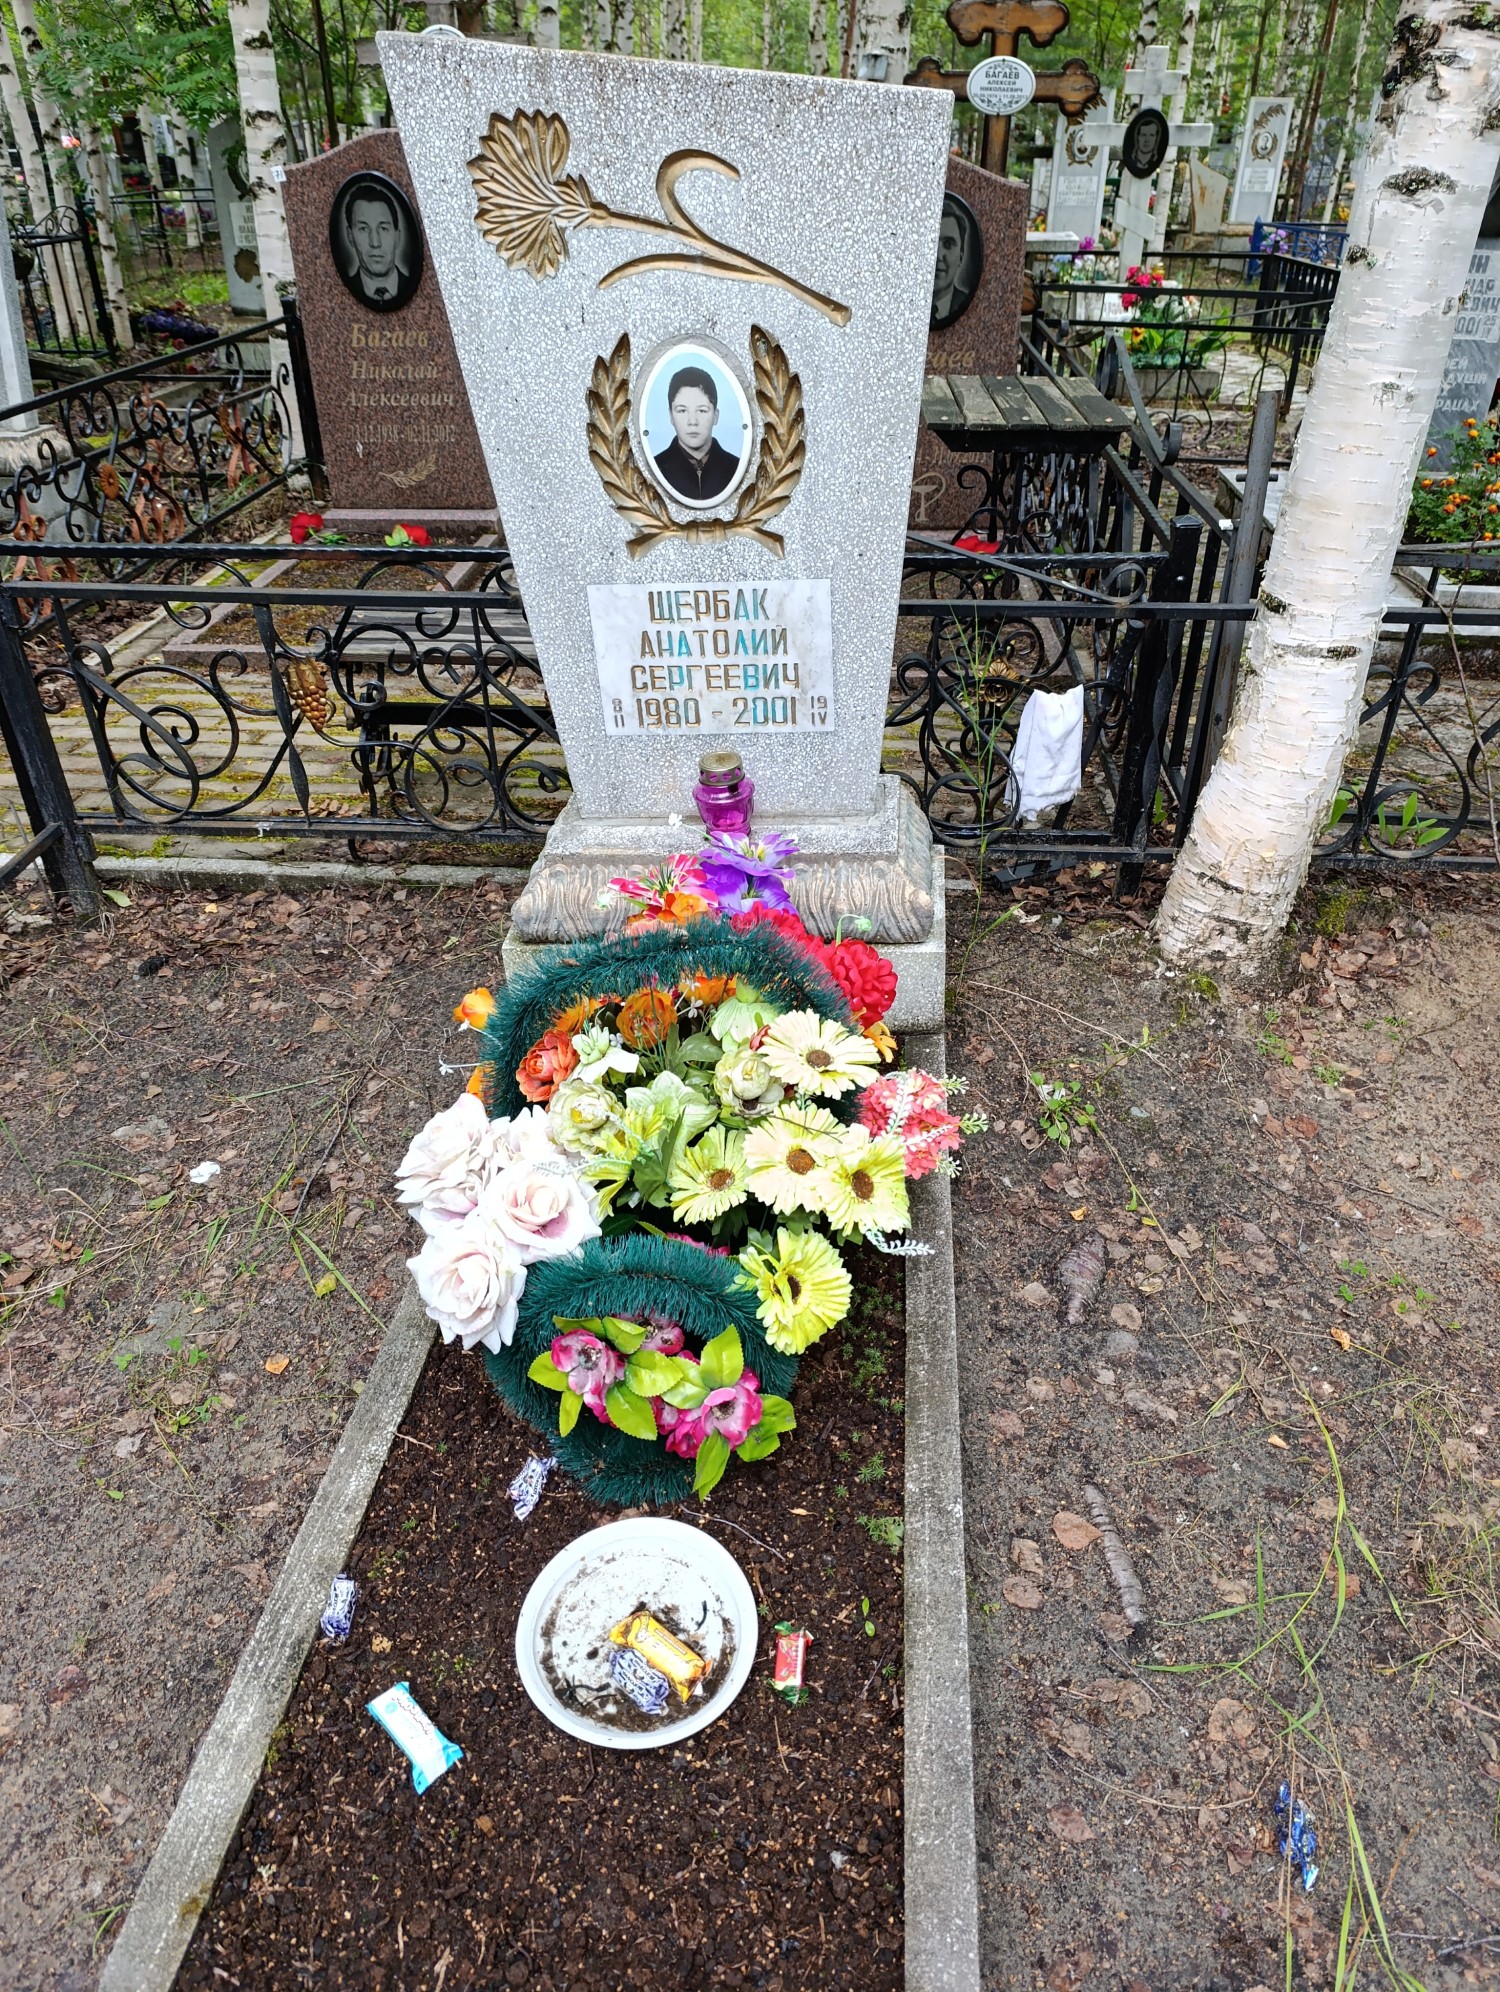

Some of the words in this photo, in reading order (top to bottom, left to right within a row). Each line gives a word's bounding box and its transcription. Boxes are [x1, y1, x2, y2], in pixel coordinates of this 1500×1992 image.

[985, 71, 1020, 80] БАГАЕВ
[351, 323, 429, 347] Багаев
[351, 361, 439, 380] Николай
[343, 390, 454, 407] Алексеевич
[648, 588, 770, 624] ЩЕРБАК
[640, 625, 788, 658] АНАТОЛИЙ
[631, 663, 800, 693] СЕРГЕЕВИЧ
[636, 697, 701, 728] 1980
[732, 696, 798, 727] 2001
[811, 695, 828, 709] 19
